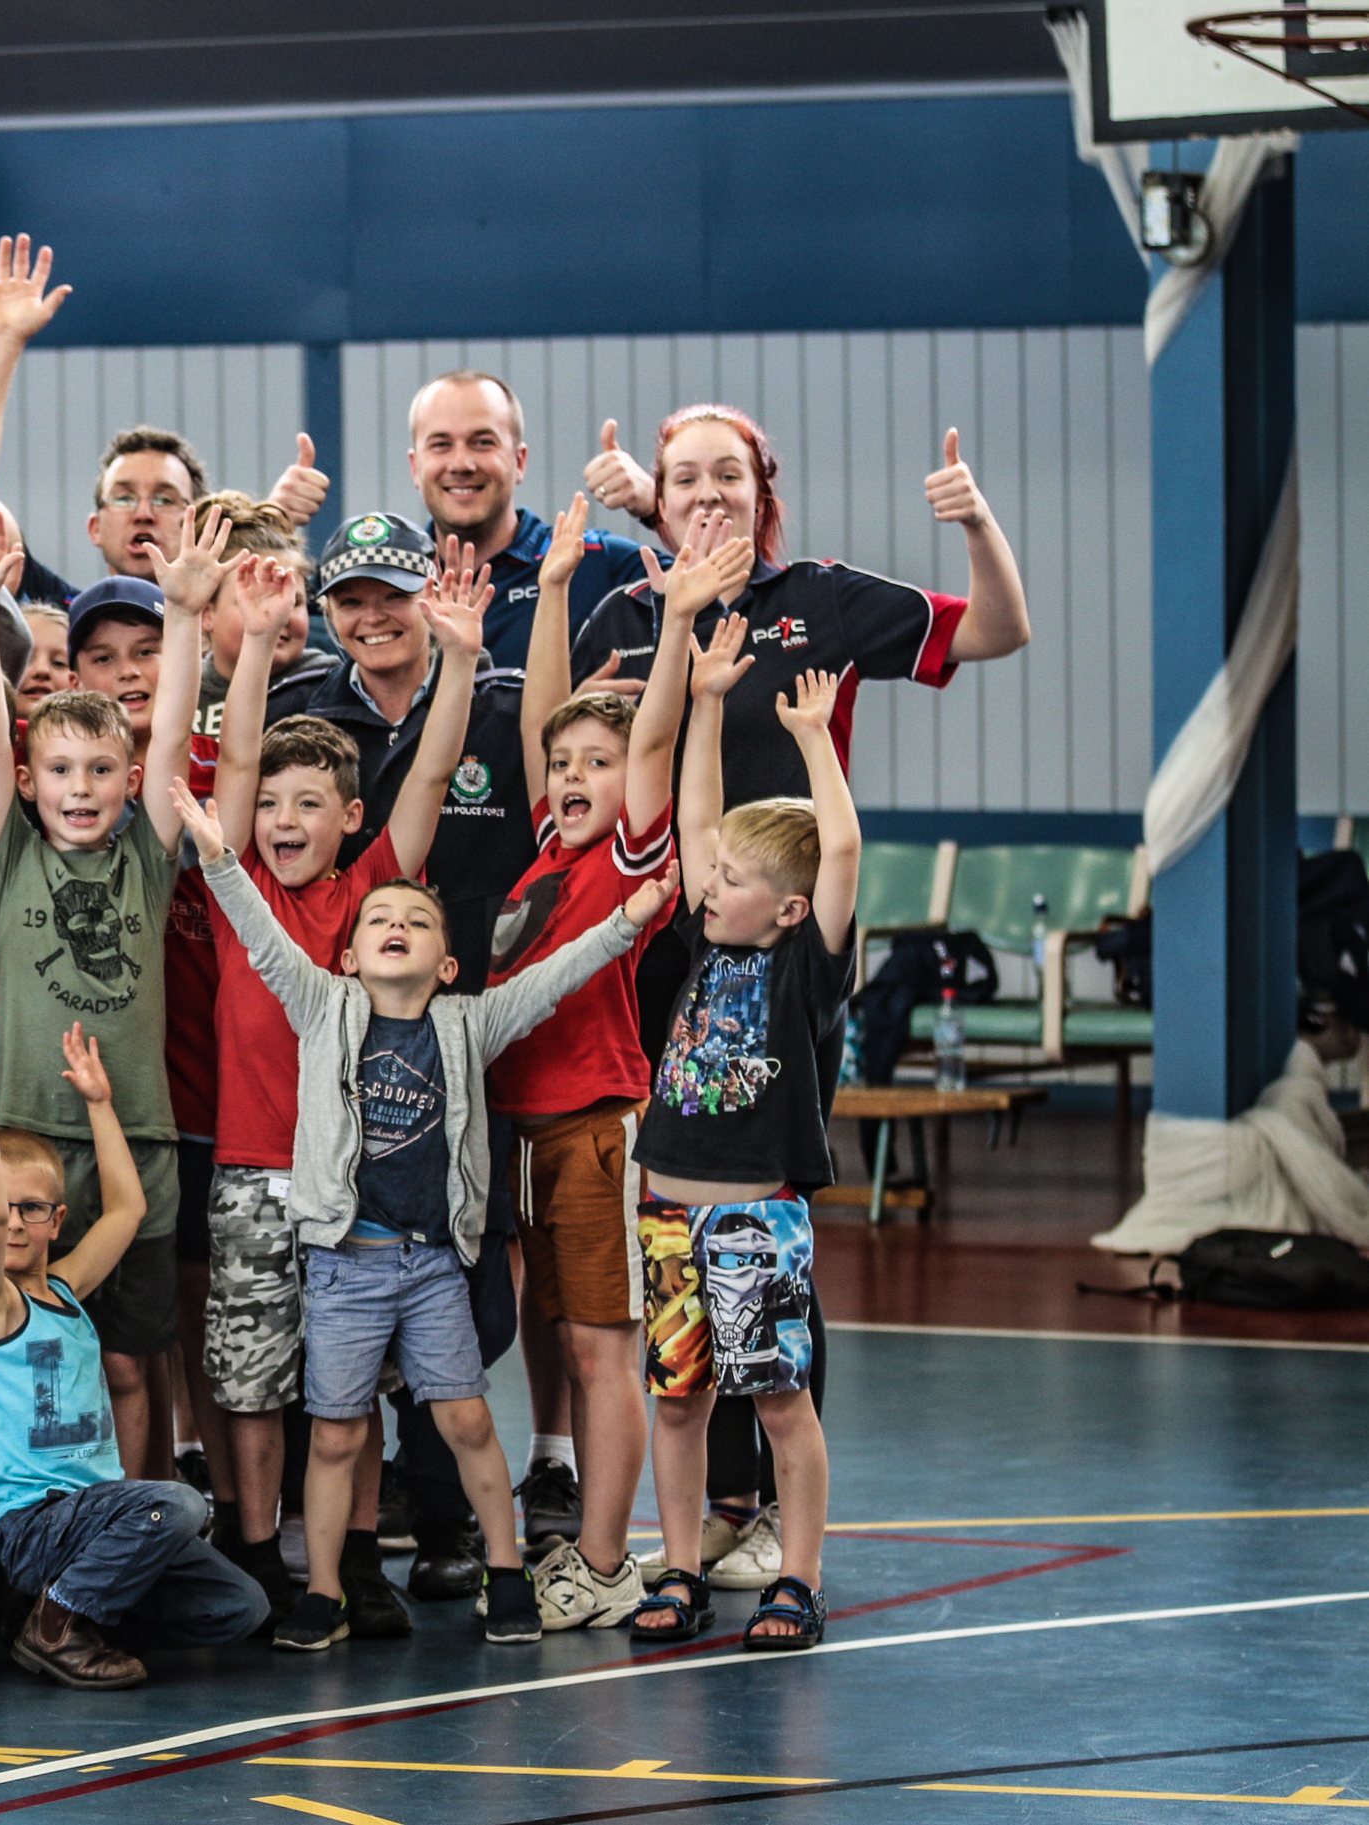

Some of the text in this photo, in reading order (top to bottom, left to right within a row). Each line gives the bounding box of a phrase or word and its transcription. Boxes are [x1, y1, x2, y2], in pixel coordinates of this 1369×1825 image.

[752, 616, 807, 645] PCYC
[454, 806, 481, 816] POLICE
[483, 807, 505, 818] FORCE
[22, 907, 48, 929] 19
[48, 980, 139, 1015] PARADISE
